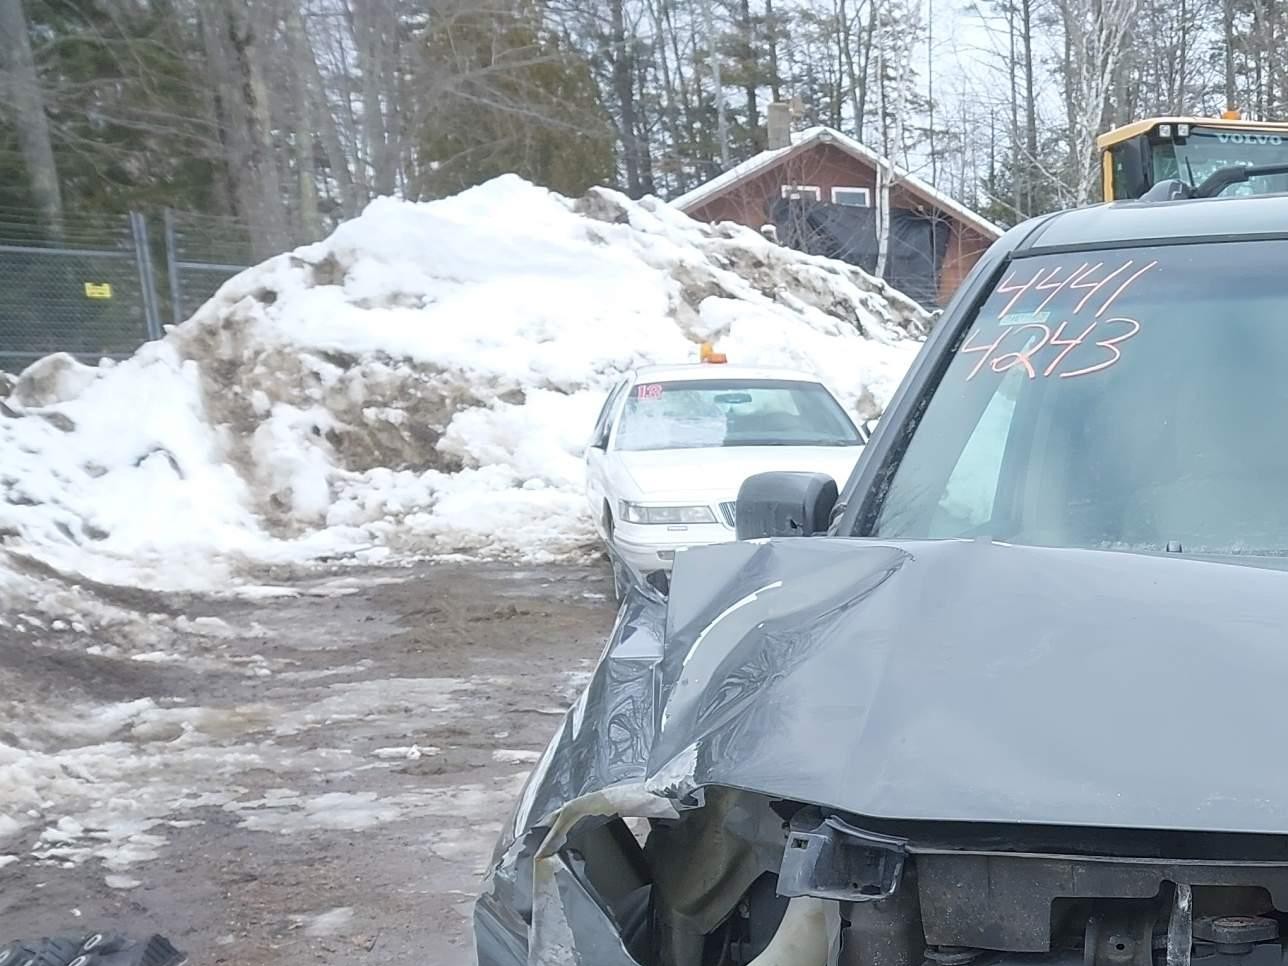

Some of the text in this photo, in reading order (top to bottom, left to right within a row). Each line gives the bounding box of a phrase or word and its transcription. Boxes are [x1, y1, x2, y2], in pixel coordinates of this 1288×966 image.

[1215, 133, 1282, 145] VOLVO
[997, 260, 1159, 320] 4441
[960, 317, 1141, 382] 4243
